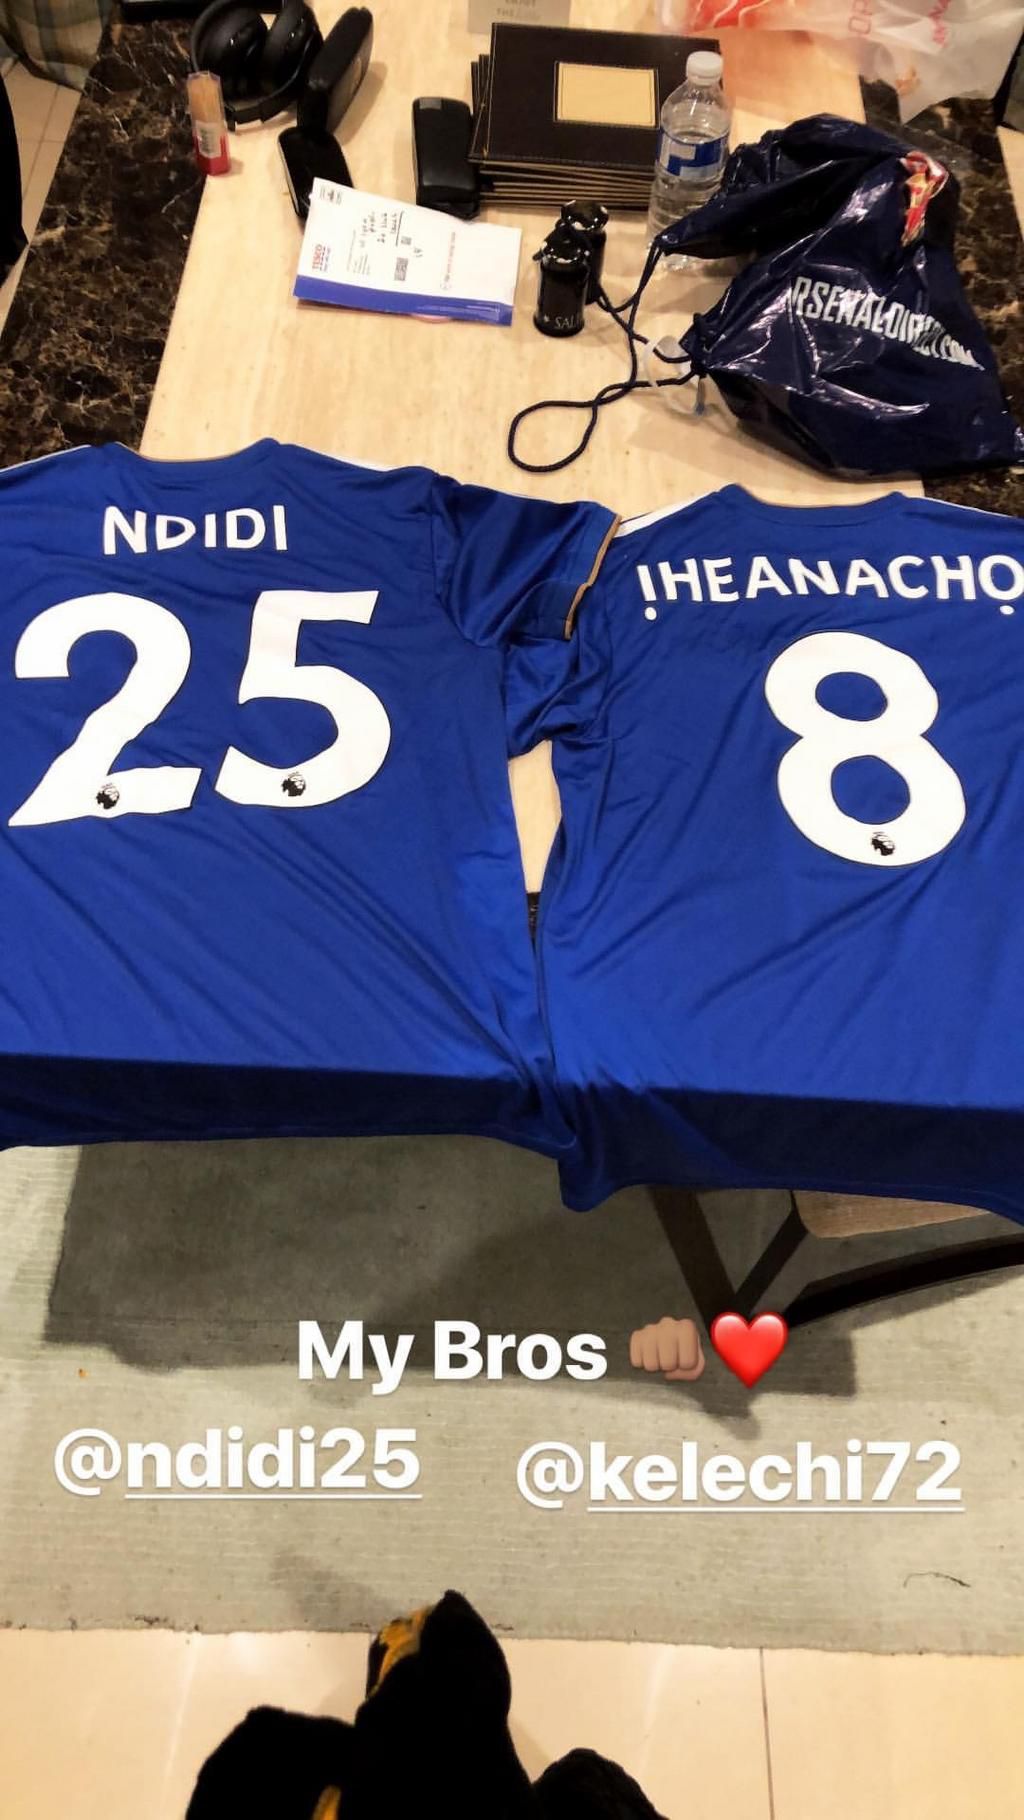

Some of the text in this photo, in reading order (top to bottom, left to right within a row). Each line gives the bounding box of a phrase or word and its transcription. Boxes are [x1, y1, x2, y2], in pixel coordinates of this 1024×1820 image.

[103, 505, 288, 555] NDIDI
[8, 589, 391, 828] 25
[764, 630, 967, 867] 8
